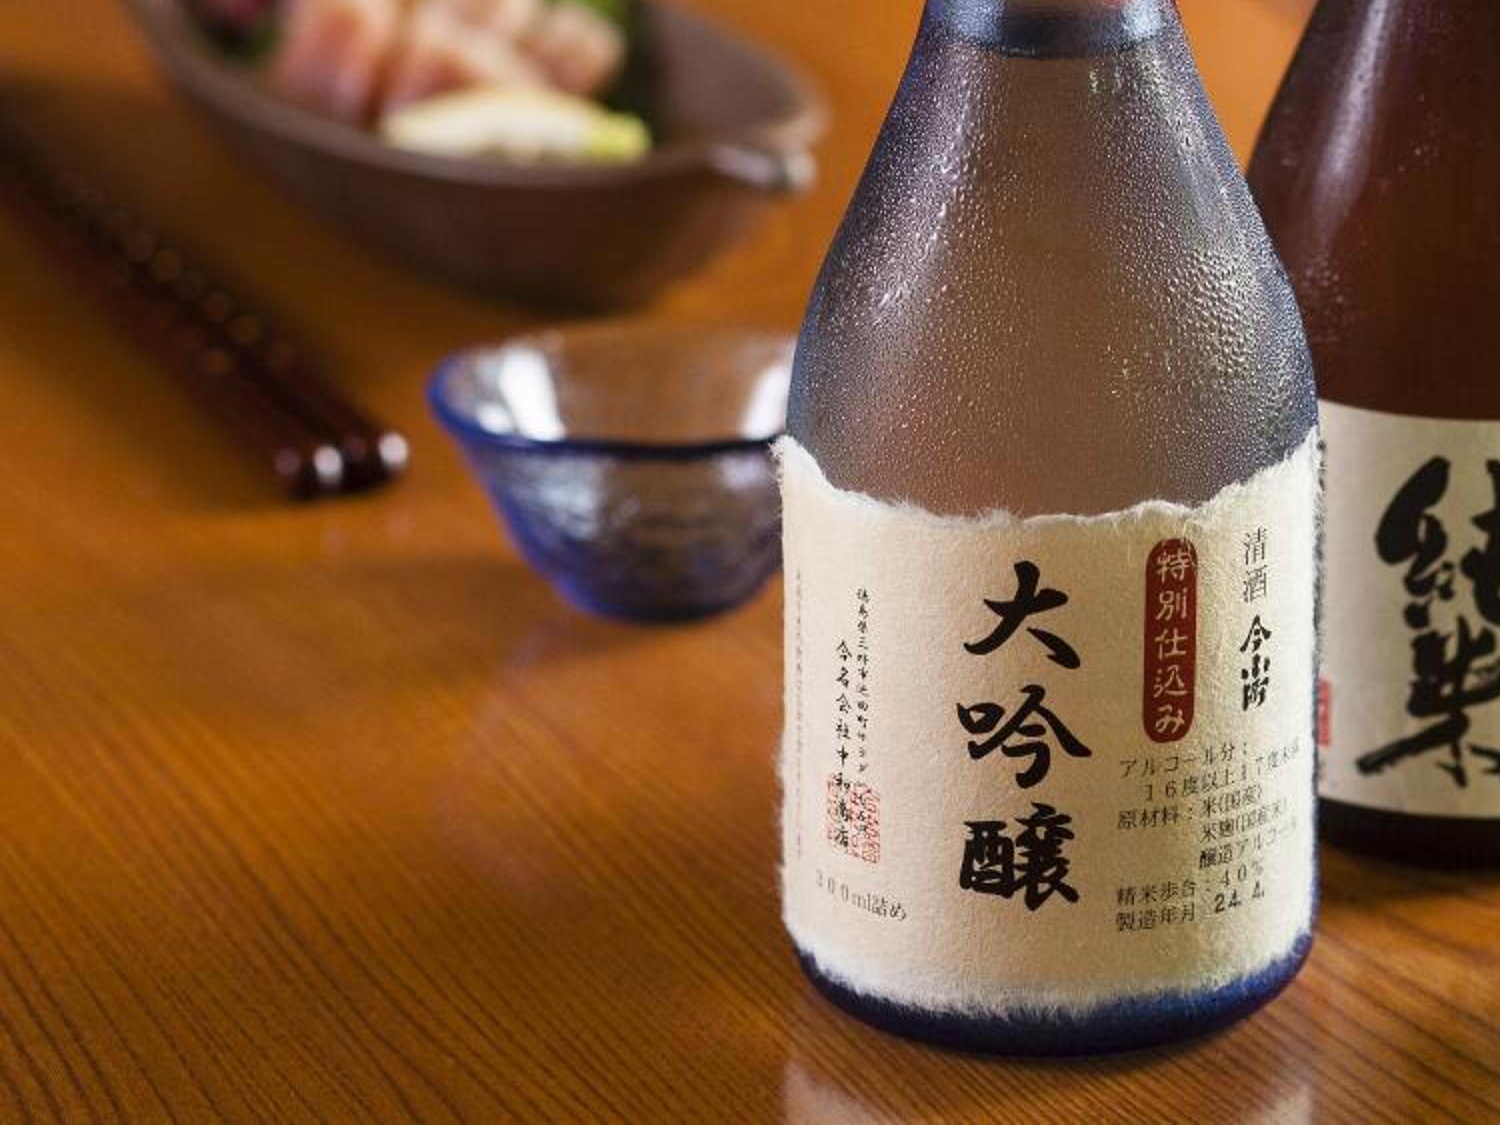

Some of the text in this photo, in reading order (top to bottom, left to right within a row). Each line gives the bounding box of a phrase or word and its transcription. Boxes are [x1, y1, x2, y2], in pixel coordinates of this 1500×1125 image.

[1153, 548, 1191, 735] 特別仕込み
[1240, 526, 1268, 604] 清酒
[956, 560, 1093, 912] 大吟醸
